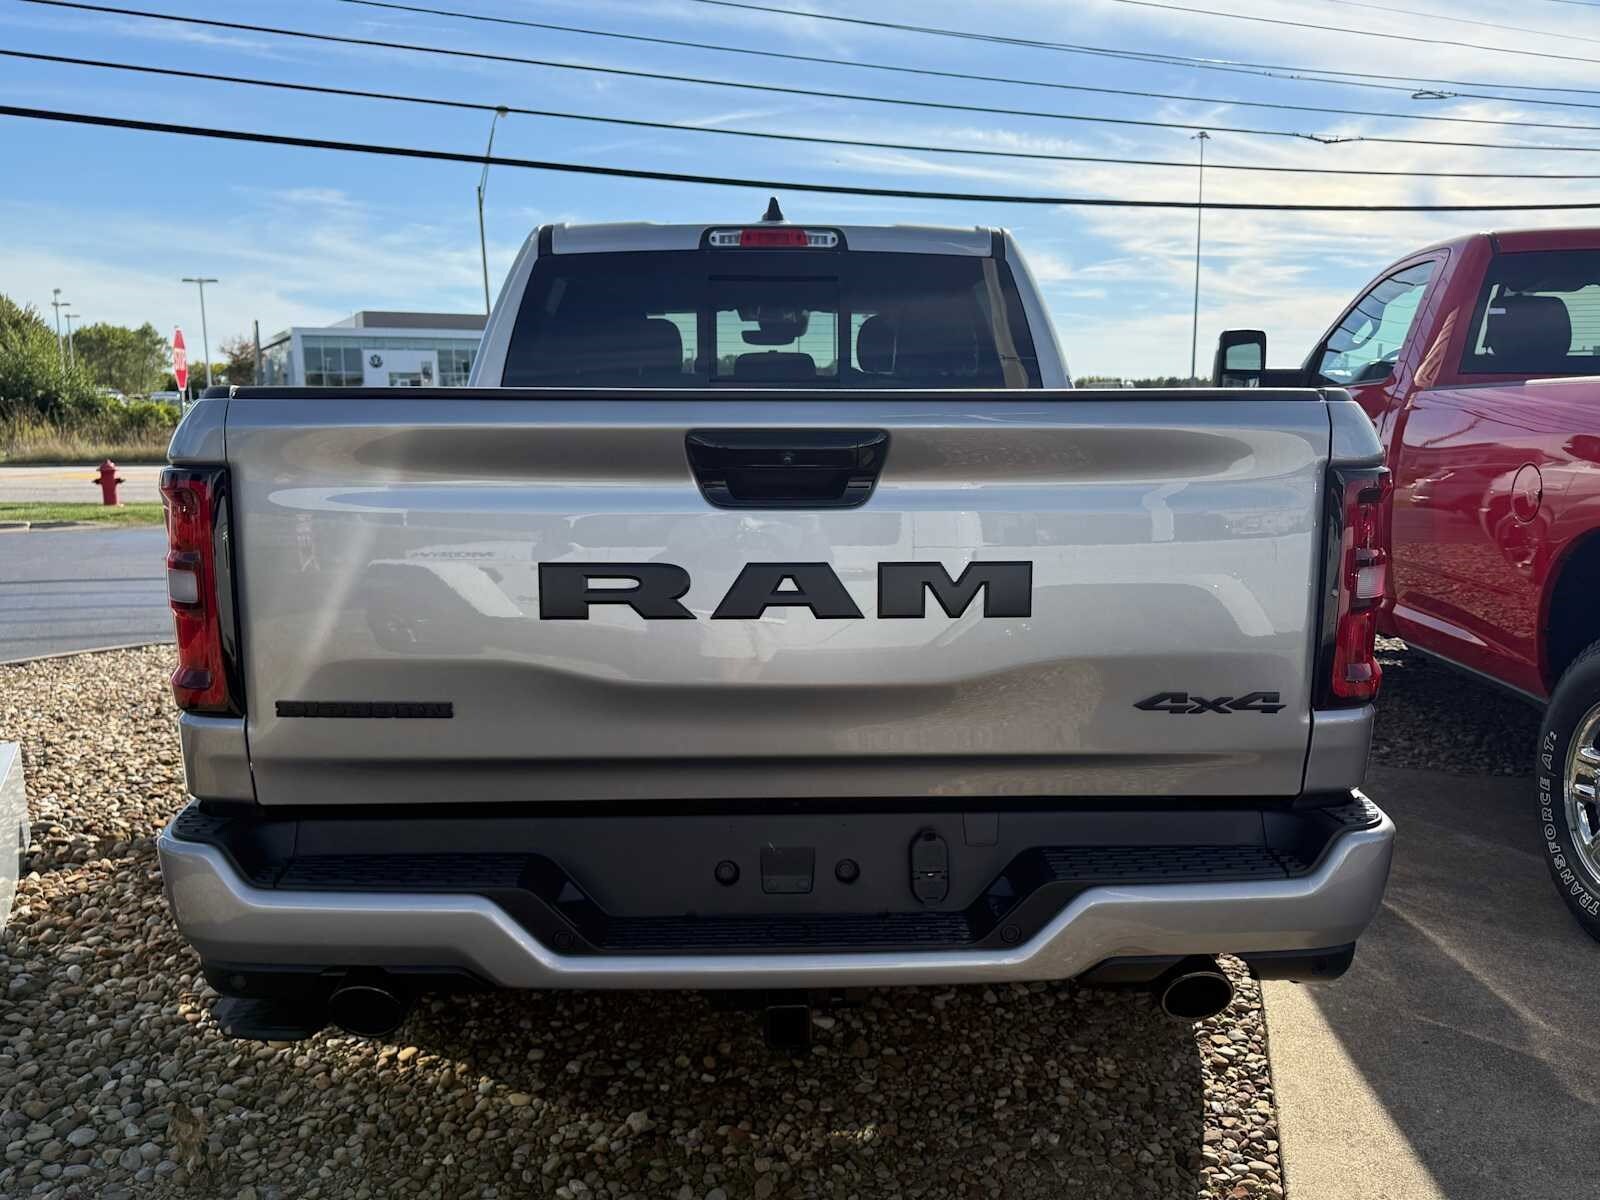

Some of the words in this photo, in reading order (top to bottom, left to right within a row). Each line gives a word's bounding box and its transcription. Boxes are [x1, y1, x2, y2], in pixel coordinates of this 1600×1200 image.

[174, 349, 186, 370] STOP
[538, 561, 1033, 620] RAM
[1539, 776, 1600, 916] TRANSFORCE
